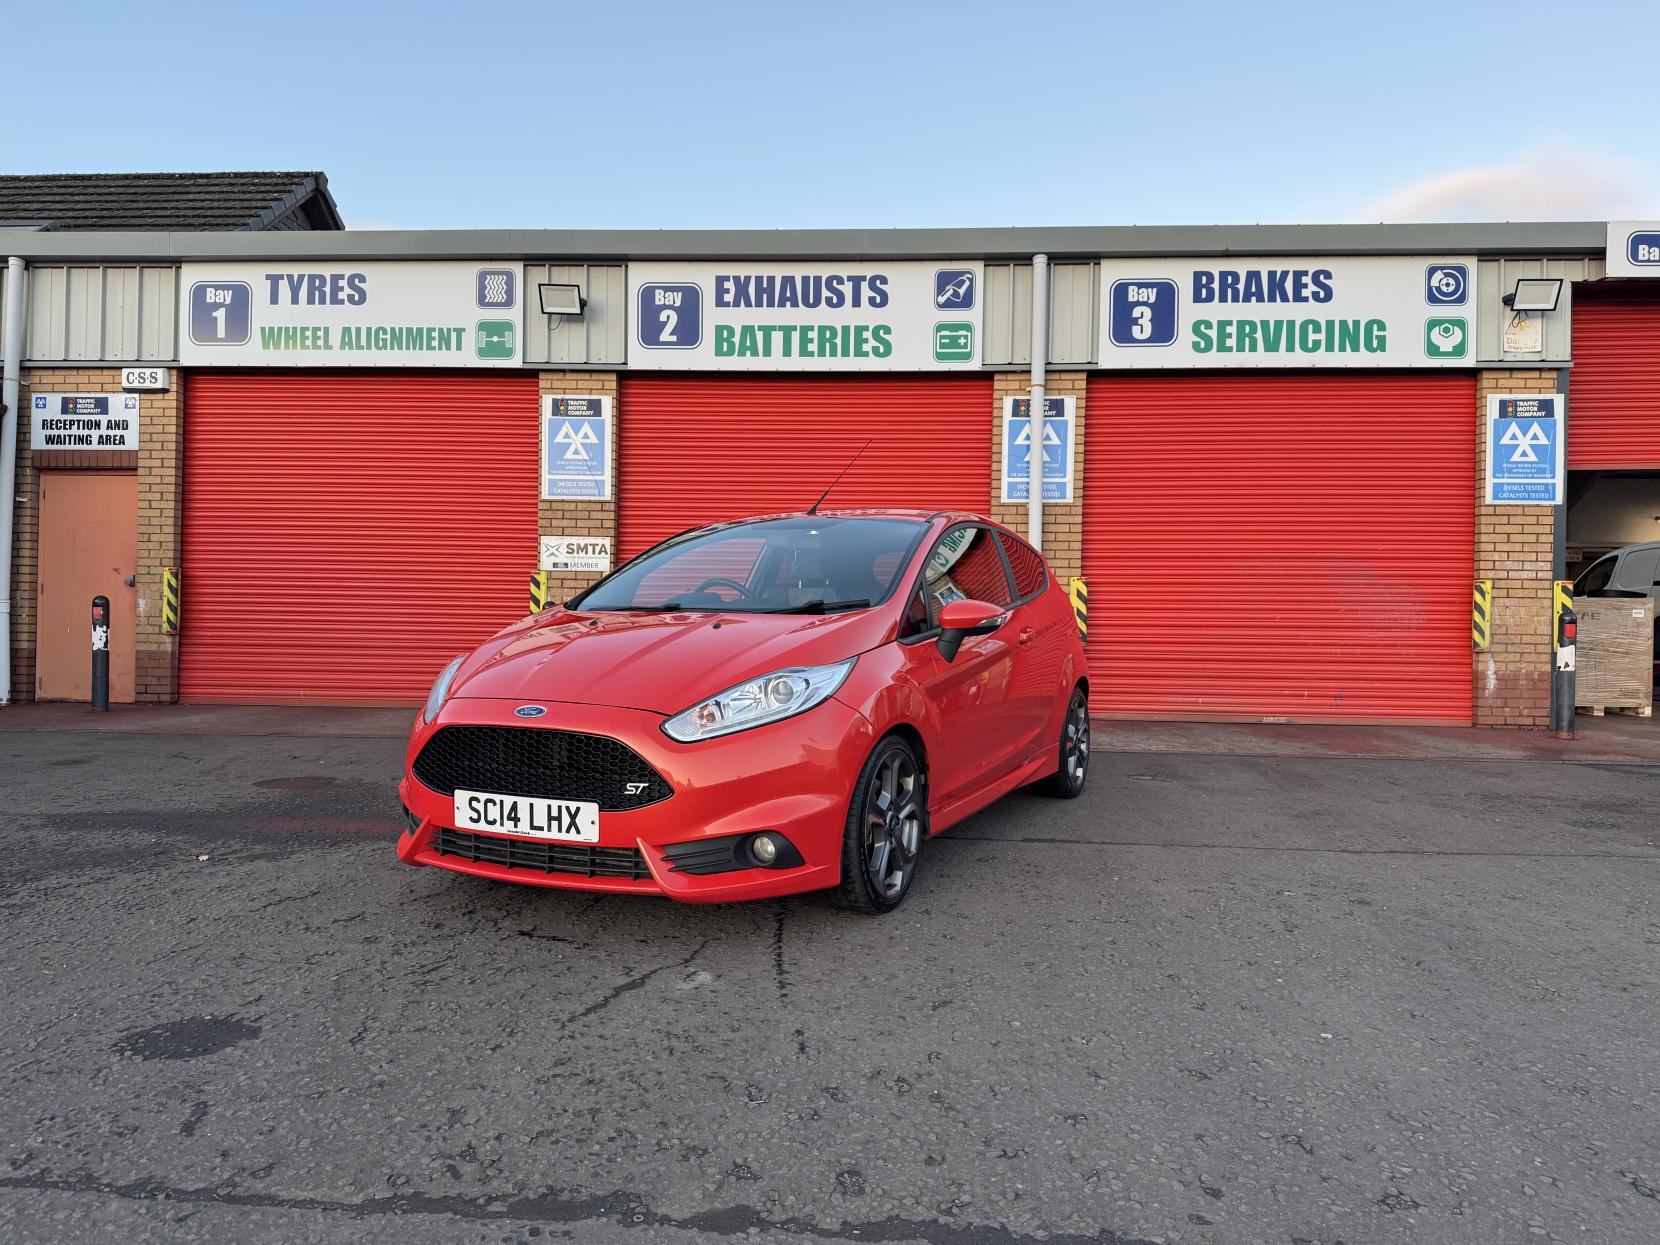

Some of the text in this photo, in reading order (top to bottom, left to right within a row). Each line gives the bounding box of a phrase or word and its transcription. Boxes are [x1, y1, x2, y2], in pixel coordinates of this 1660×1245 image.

[1638, 244, 1660, 261] Ba
[206, 287, 232, 305] Bay
[265, 273, 368, 306] TYRES
[654, 289, 682, 307] Bay
[714, 274, 889, 309] EXHAUSTS
[1127, 285, 1157, 304] Bay
[1192, 269, 1333, 304] BRAKES
[211, 307, 226, 339] 1
[658, 309, 678, 342] 2
[1131, 305, 1153, 340] 3
[1190, 318, 1387, 354] SERVICING
[259, 326, 466, 352] WHEEL ALIGNMENT
[714, 324, 892, 359] BATTERIES
[41, 419, 129, 431] RECEPTION AND
[44, 434, 126, 446] WAITING AREA
[565, 542, 609, 555] SMTA
[624, 783, 649, 794] ST
[468, 796, 582, 835] SC14 LHX
